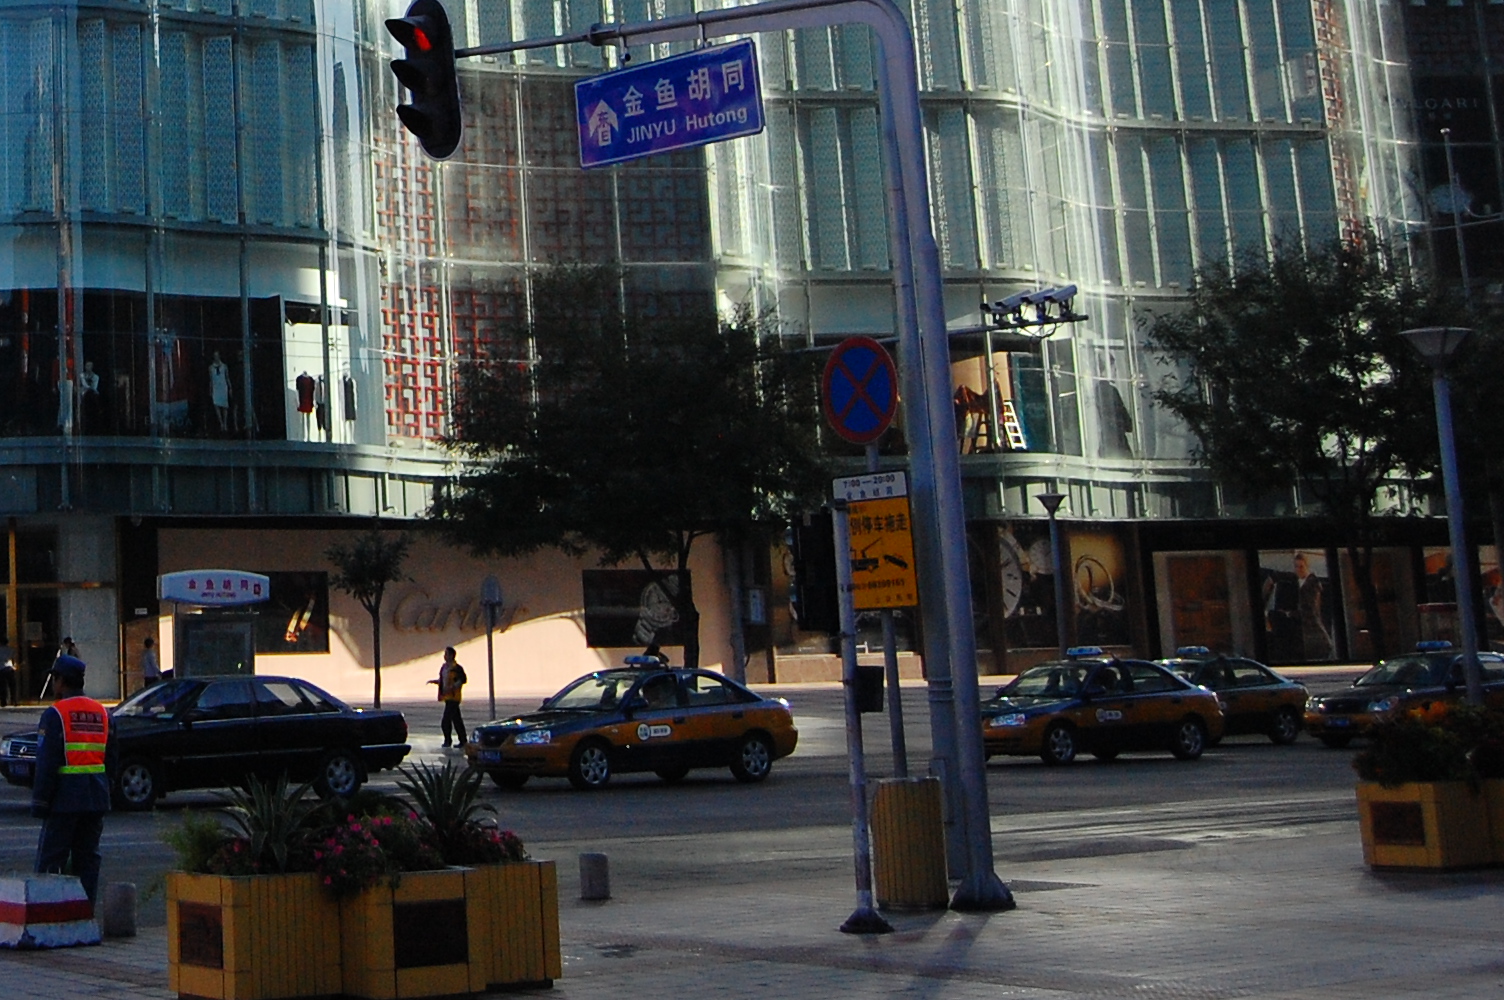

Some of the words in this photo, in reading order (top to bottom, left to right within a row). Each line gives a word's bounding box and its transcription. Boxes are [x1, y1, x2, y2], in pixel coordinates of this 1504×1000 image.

[622, 59, 745, 118] 金鱼胡同
[626, 119, 677, 145] JINYU
[686, 107, 748, 132] Hutong
